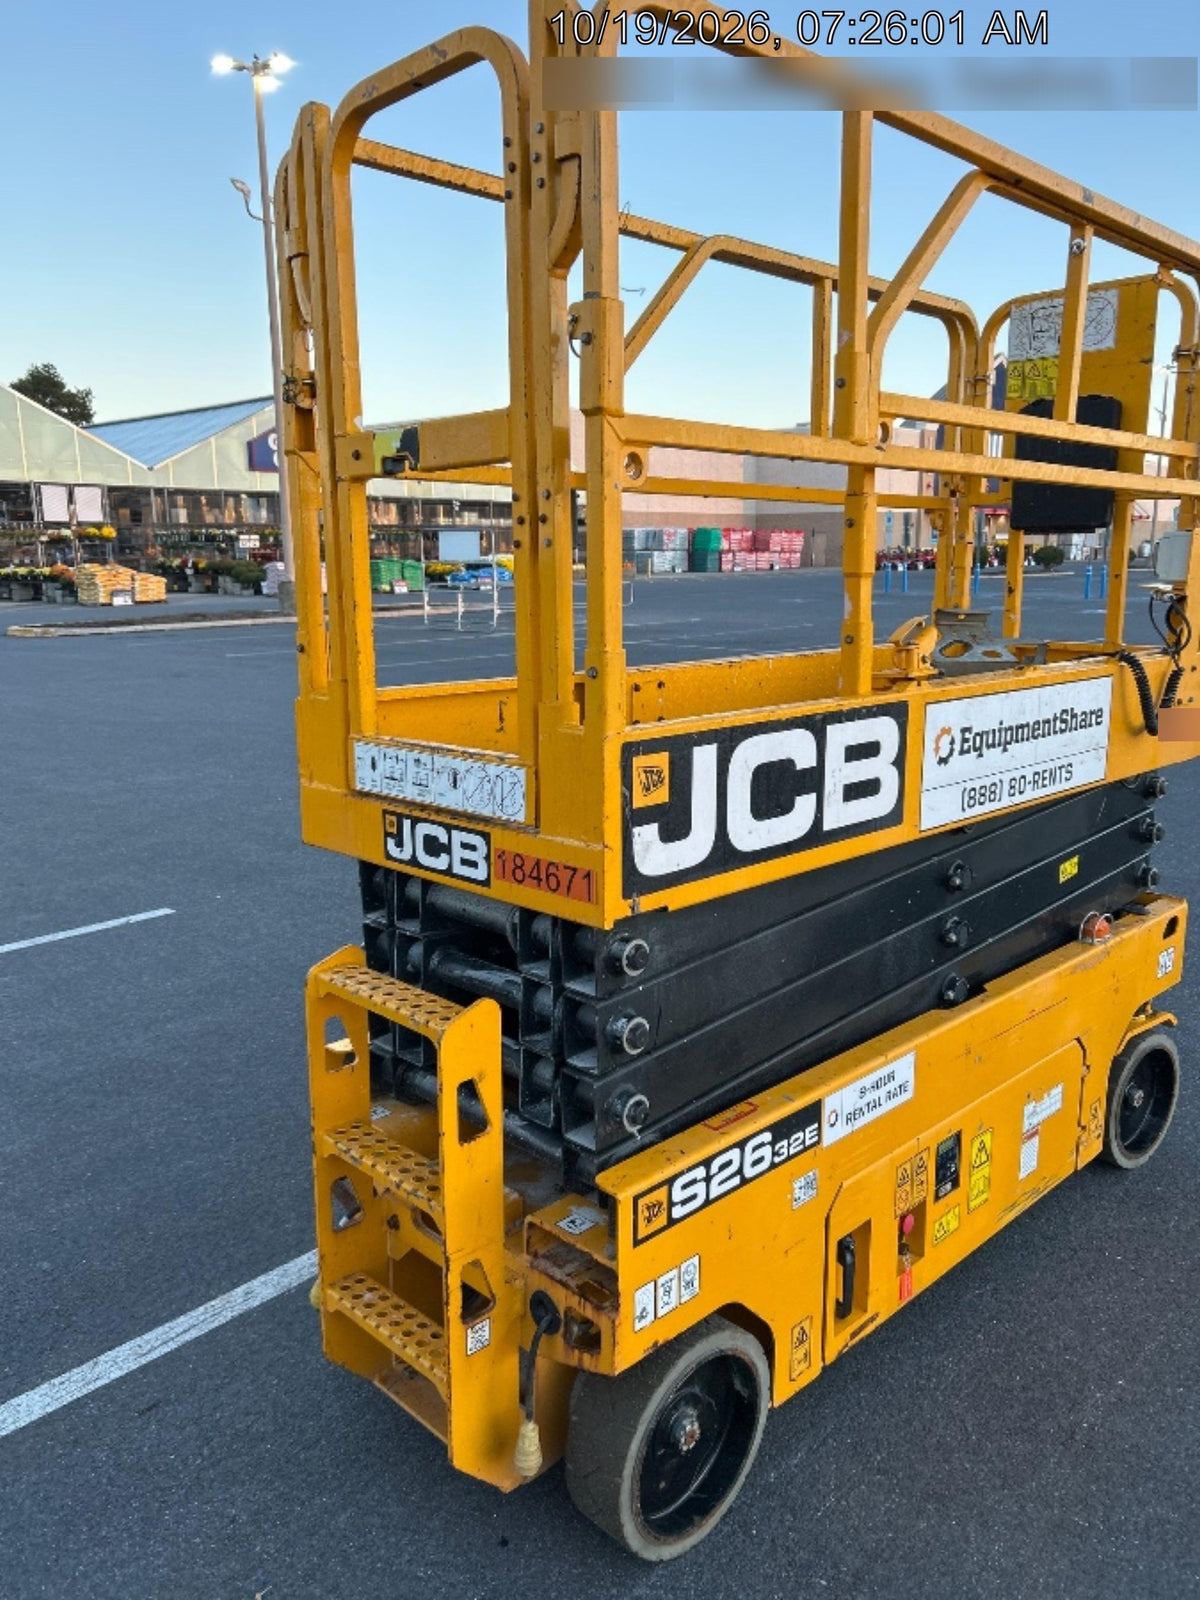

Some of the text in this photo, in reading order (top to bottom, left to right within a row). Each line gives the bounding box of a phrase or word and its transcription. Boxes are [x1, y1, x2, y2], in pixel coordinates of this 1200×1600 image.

[958, 707, 1103, 758] EquipmentShare
[632, 715, 900, 877] JCB
[961, 763, 1073, 812] (888) 80-RENTS
[387, 818, 489, 881] JCB
[497, 850, 592, 901] 184671
[846, 1080, 909, 1126] RENTAL RATE
